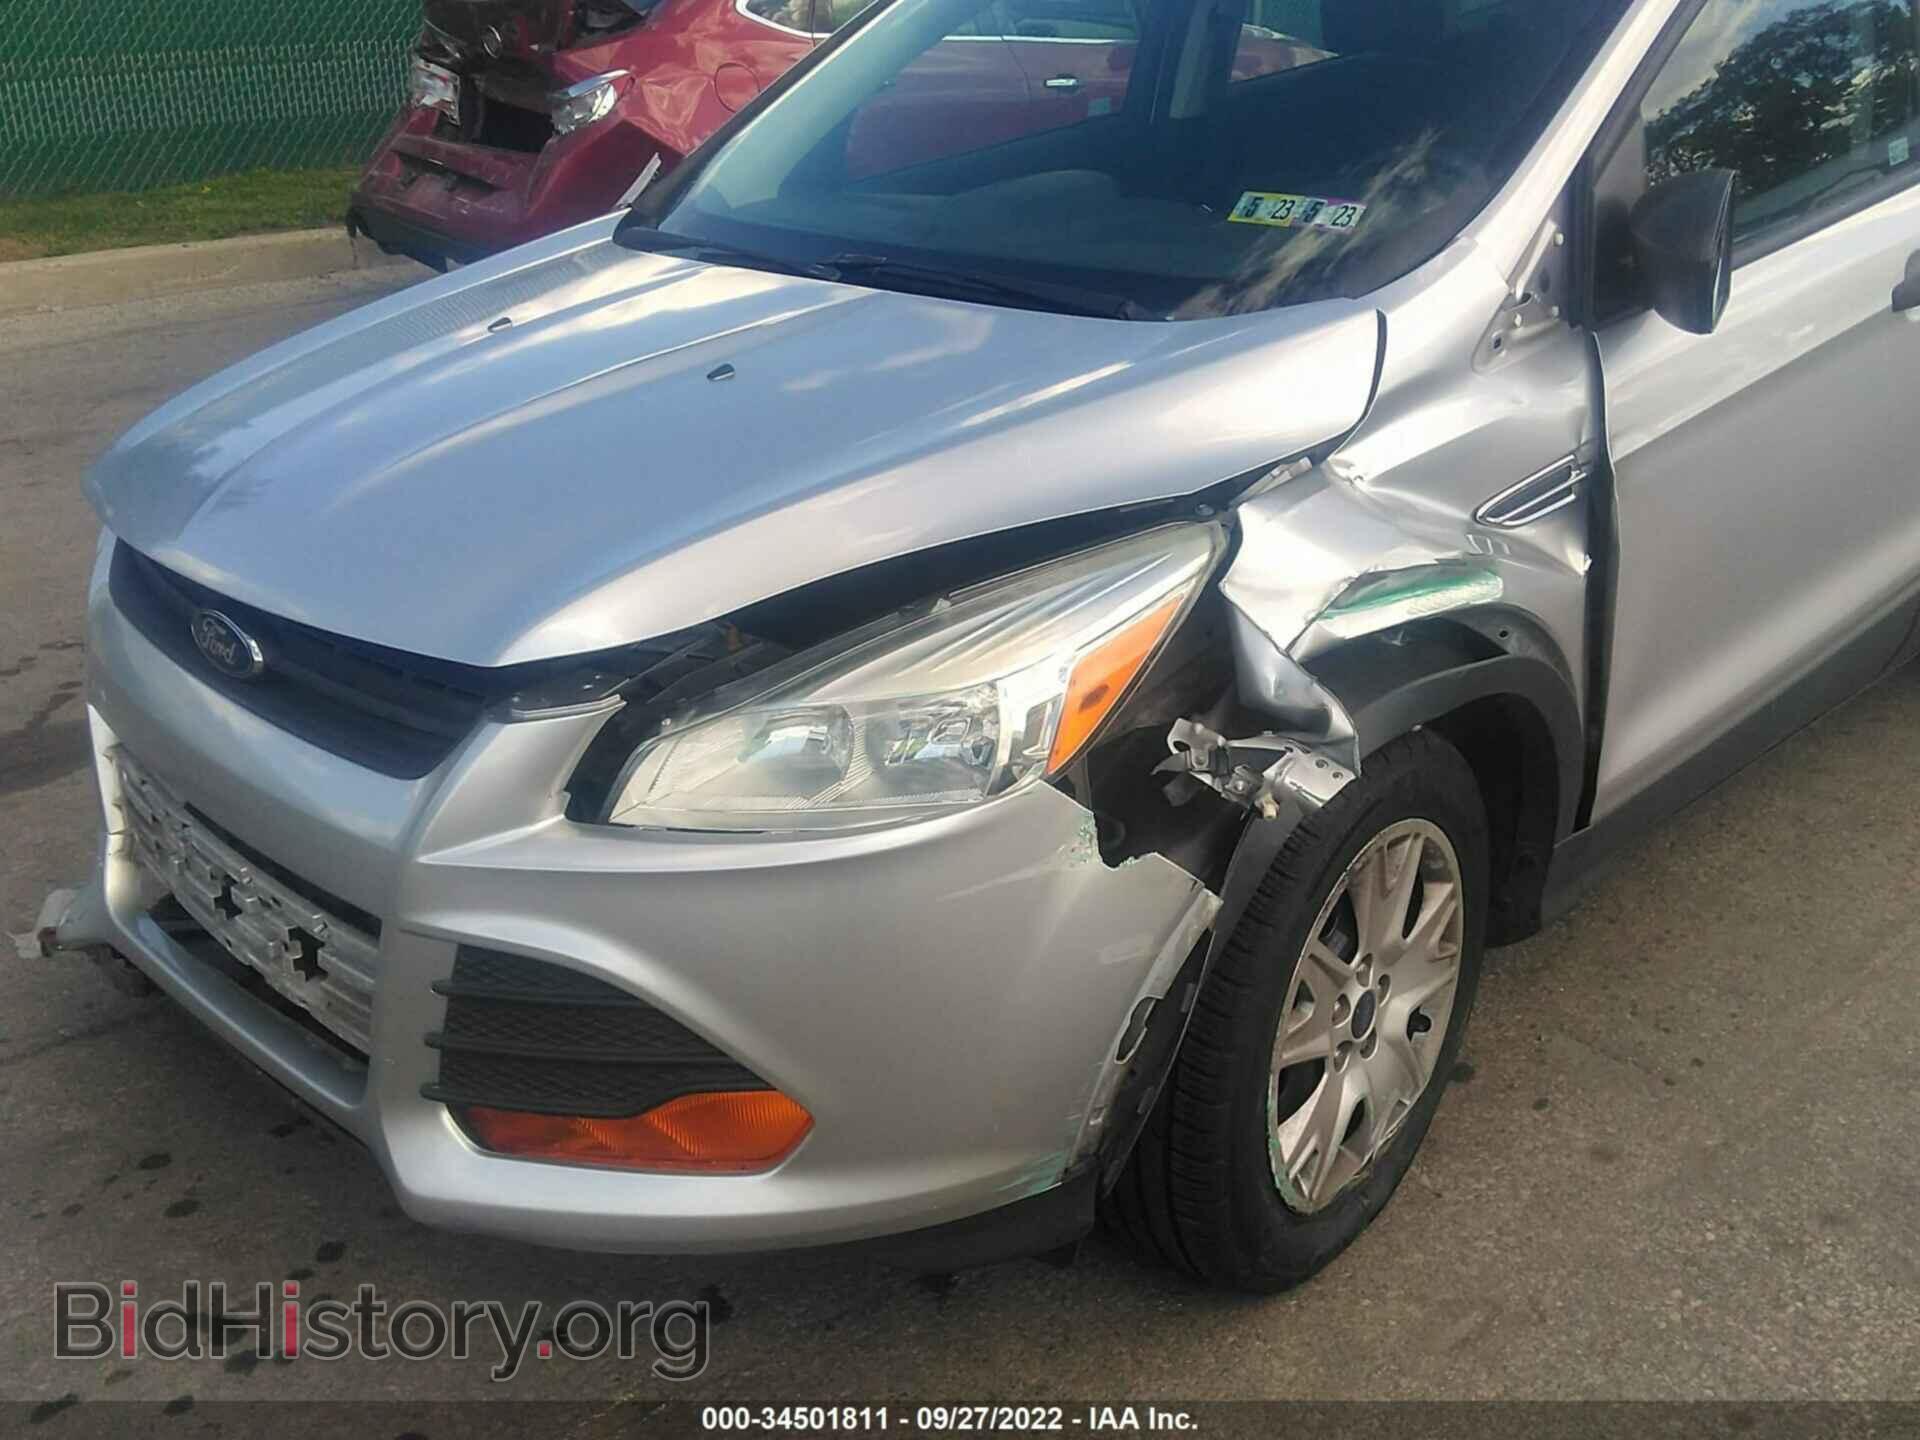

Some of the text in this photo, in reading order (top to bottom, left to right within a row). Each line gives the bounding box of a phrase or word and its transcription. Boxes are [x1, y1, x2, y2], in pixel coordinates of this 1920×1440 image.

[1270, 199, 1295, 220] 23
[1331, 205, 1357, 227] 23
[202, 617, 238, 666] Ford
